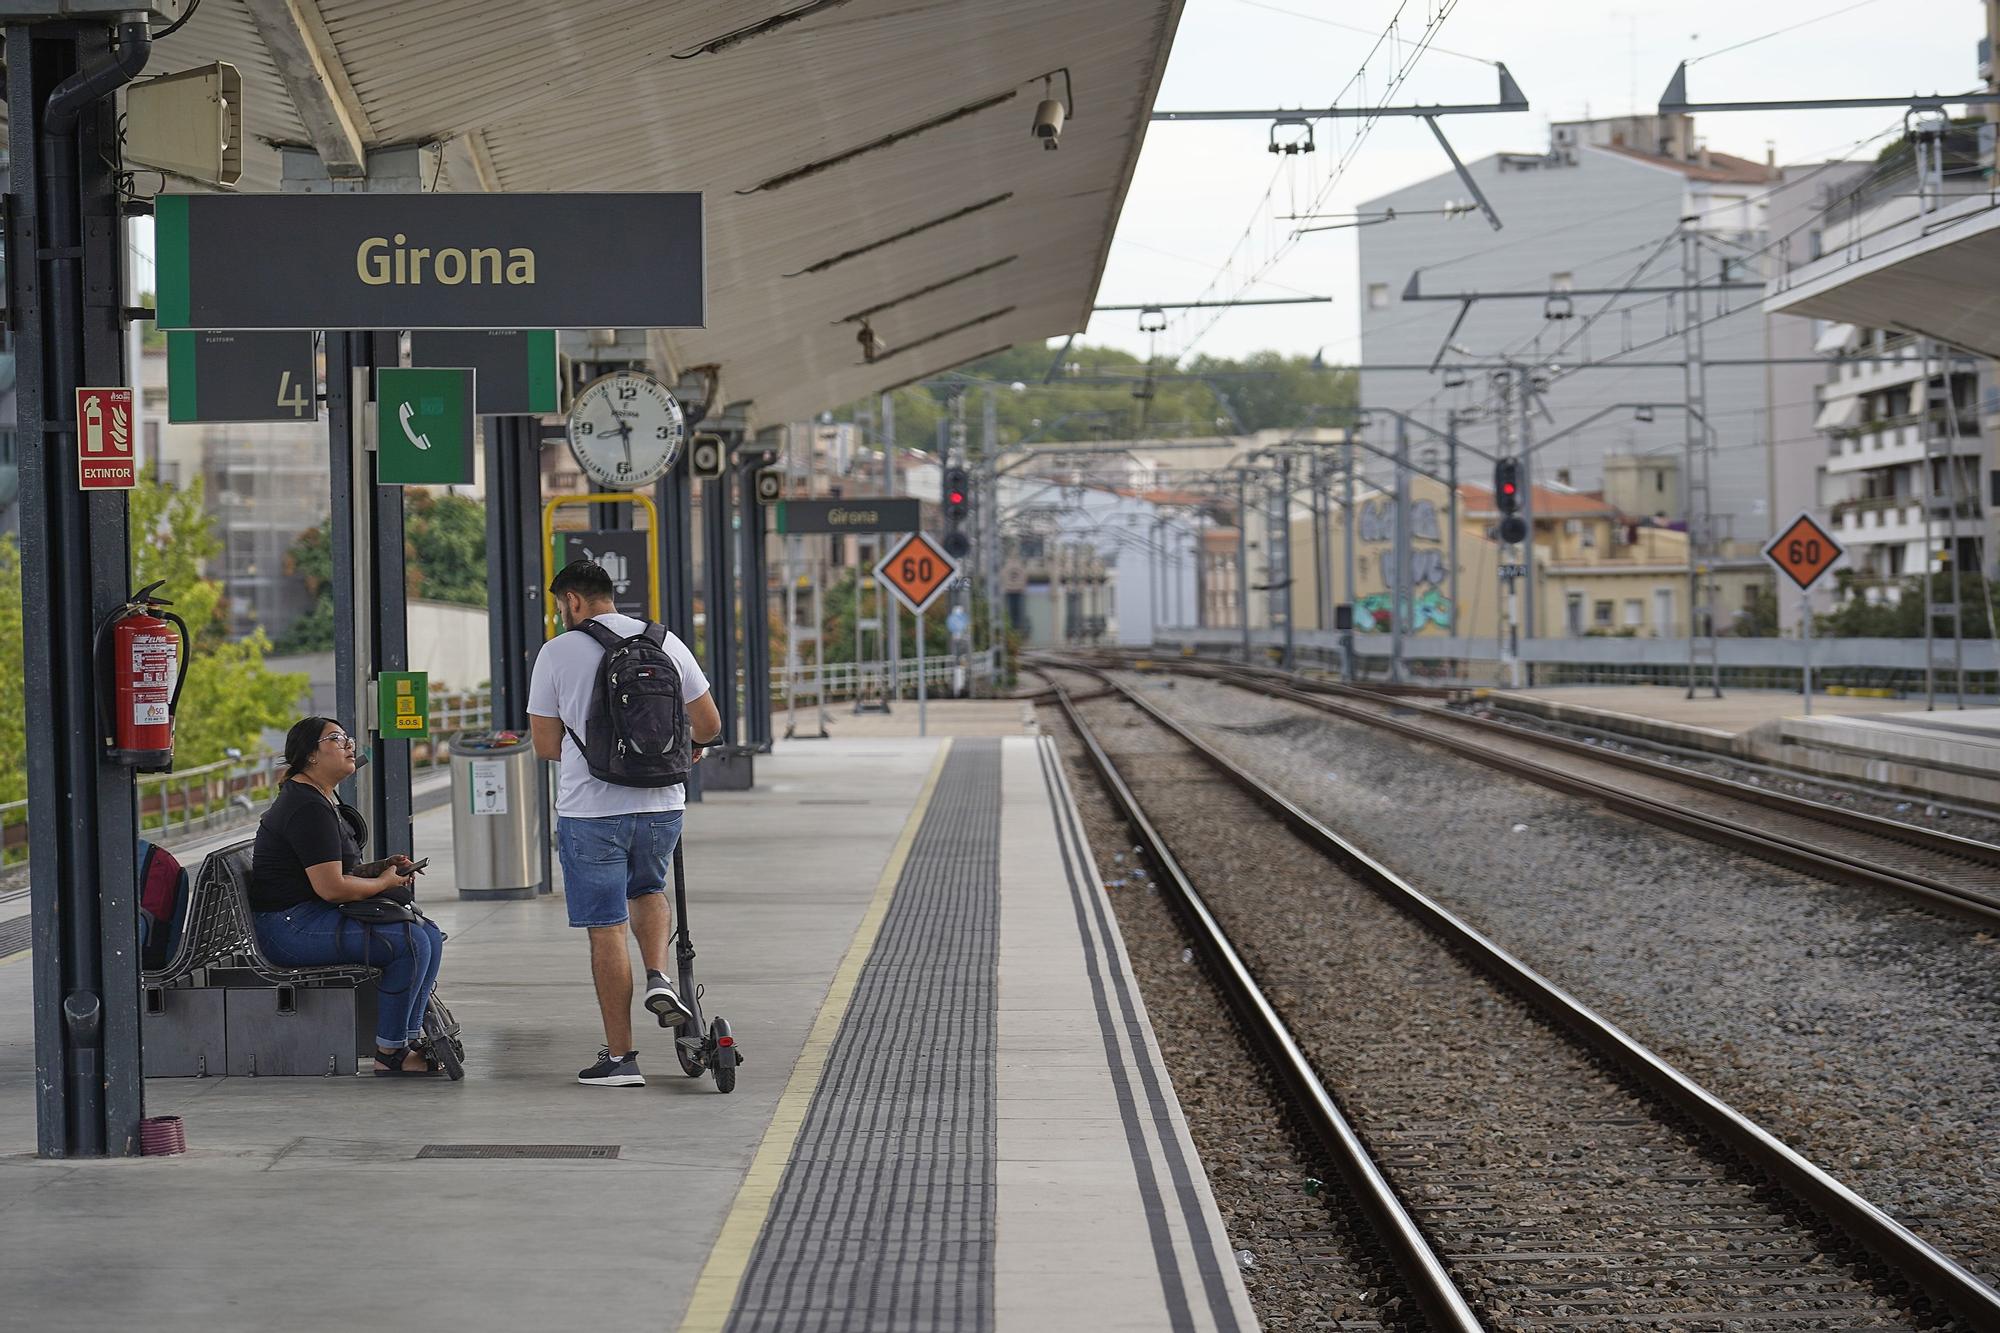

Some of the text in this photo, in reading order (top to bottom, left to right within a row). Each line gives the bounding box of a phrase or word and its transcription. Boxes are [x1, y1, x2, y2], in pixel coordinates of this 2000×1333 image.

[356, 233, 536, 286] Girona
[277, 370, 309, 417] 4
[618, 386, 637, 401] 12
[581, 421, 594, 435] 9
[656, 426, 669, 440] 3
[84, 468, 131, 479] EXTINTOR
[616, 462, 629, 475] 6
[827, 507, 879, 526] Girona
[1789, 539, 1821, 565] 60
[902, 556, 934, 584] 60
